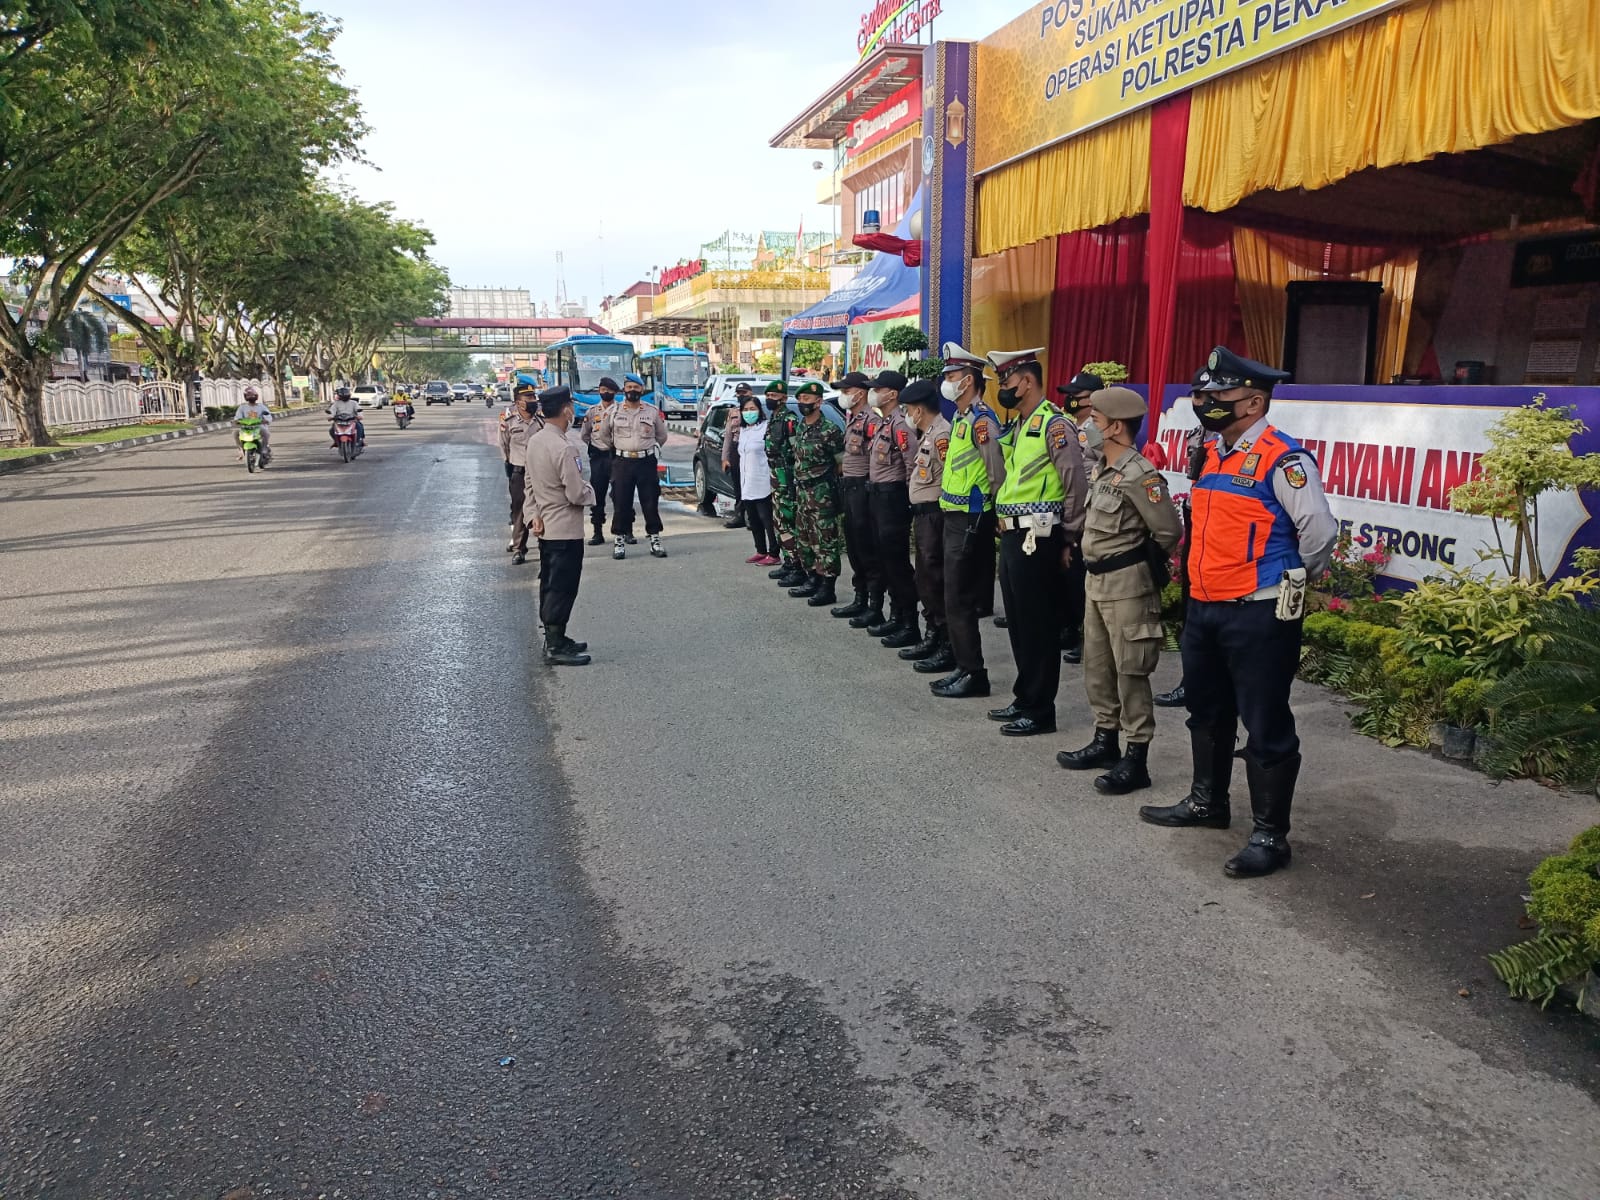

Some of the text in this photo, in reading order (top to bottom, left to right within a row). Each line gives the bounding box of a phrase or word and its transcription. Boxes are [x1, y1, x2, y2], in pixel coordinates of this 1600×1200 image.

[1075, 0, 1163, 48] SUKAR
[1045, 39, 1121, 99] OPERASI
[1121, 16, 1245, 98] POLRESTA
[1359, 523, 1457, 565] STRONG
